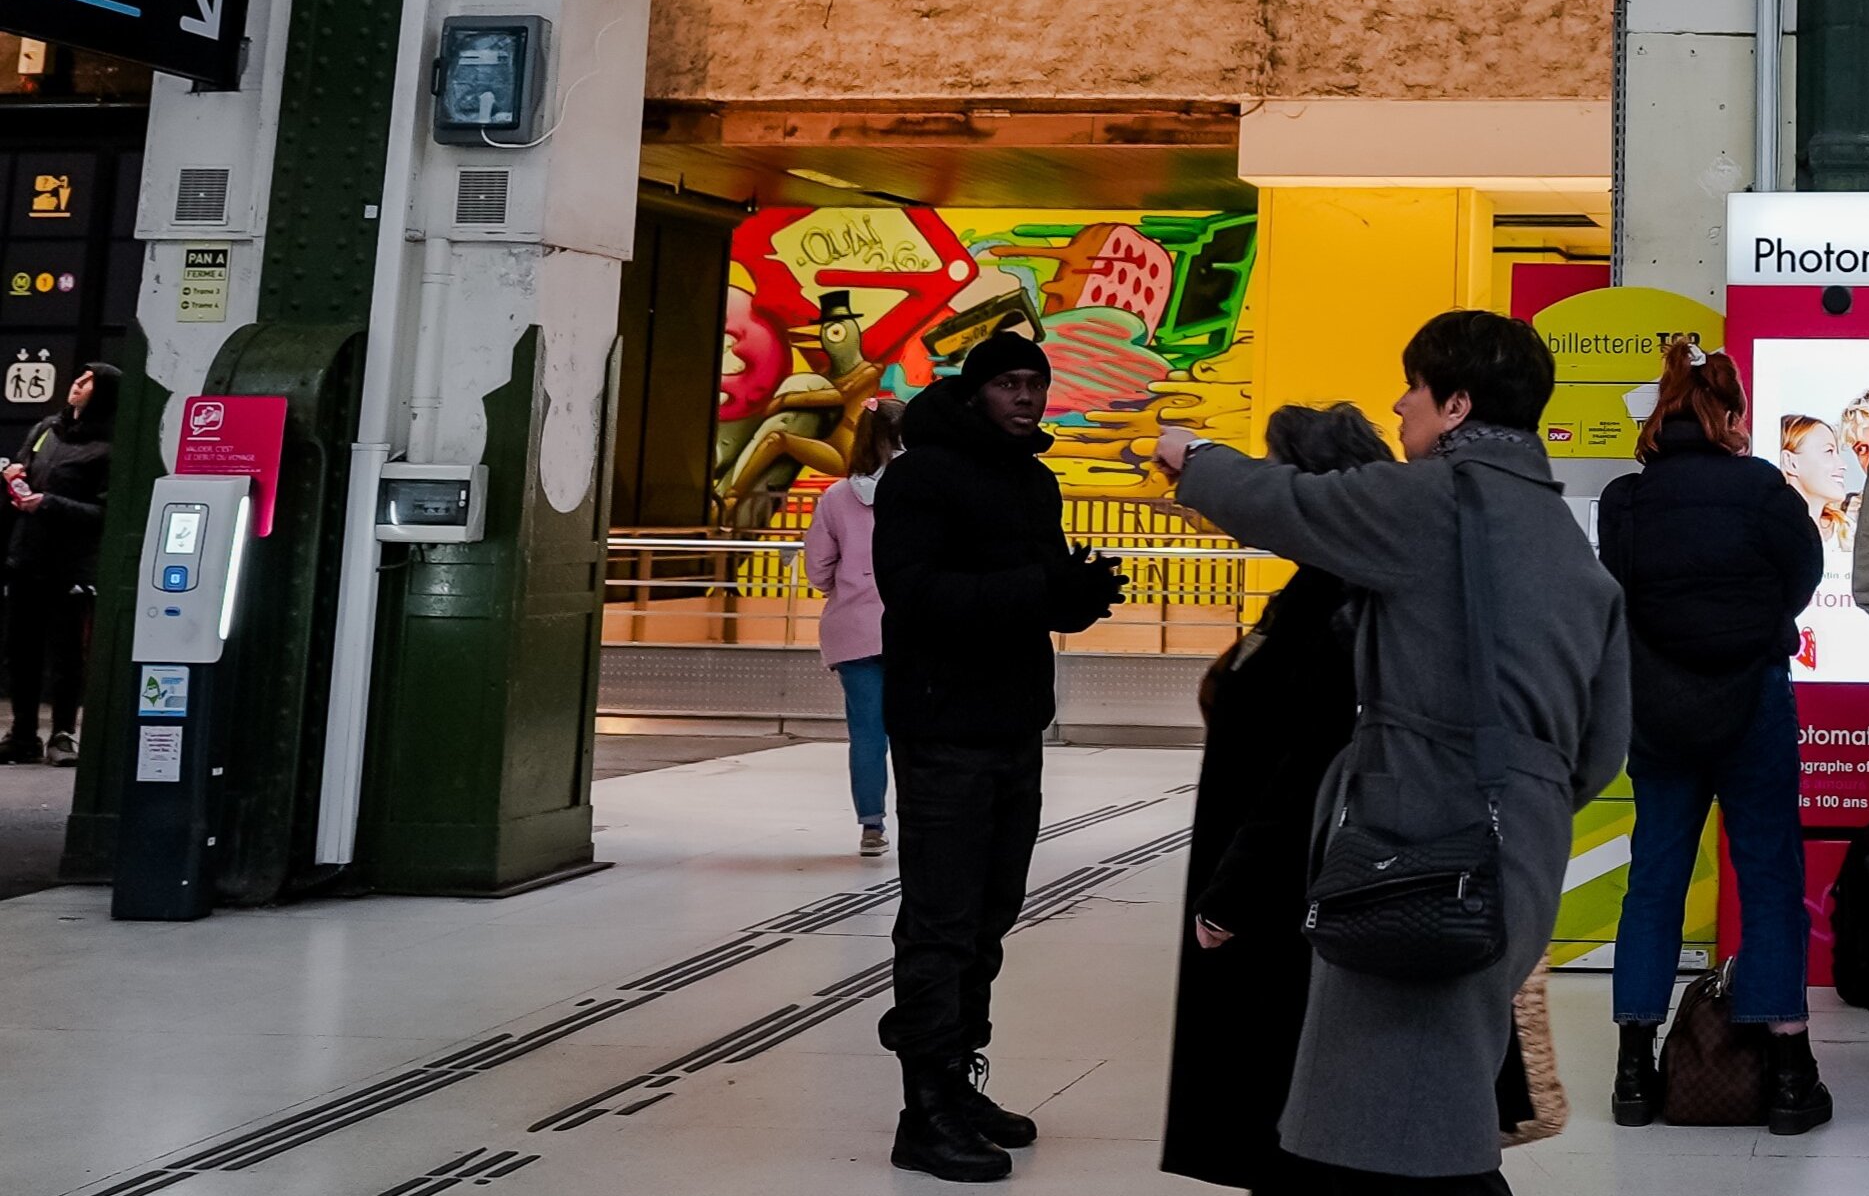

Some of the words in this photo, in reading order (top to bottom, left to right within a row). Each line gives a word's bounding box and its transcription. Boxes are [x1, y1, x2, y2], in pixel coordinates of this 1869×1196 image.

[188, 253, 213, 264] PAN
[215, 253, 225, 264] A
[1548, 332, 1652, 354] billetterie
[1815, 795, 1839, 807] 100
[1843, 799, 1868, 808] ans
